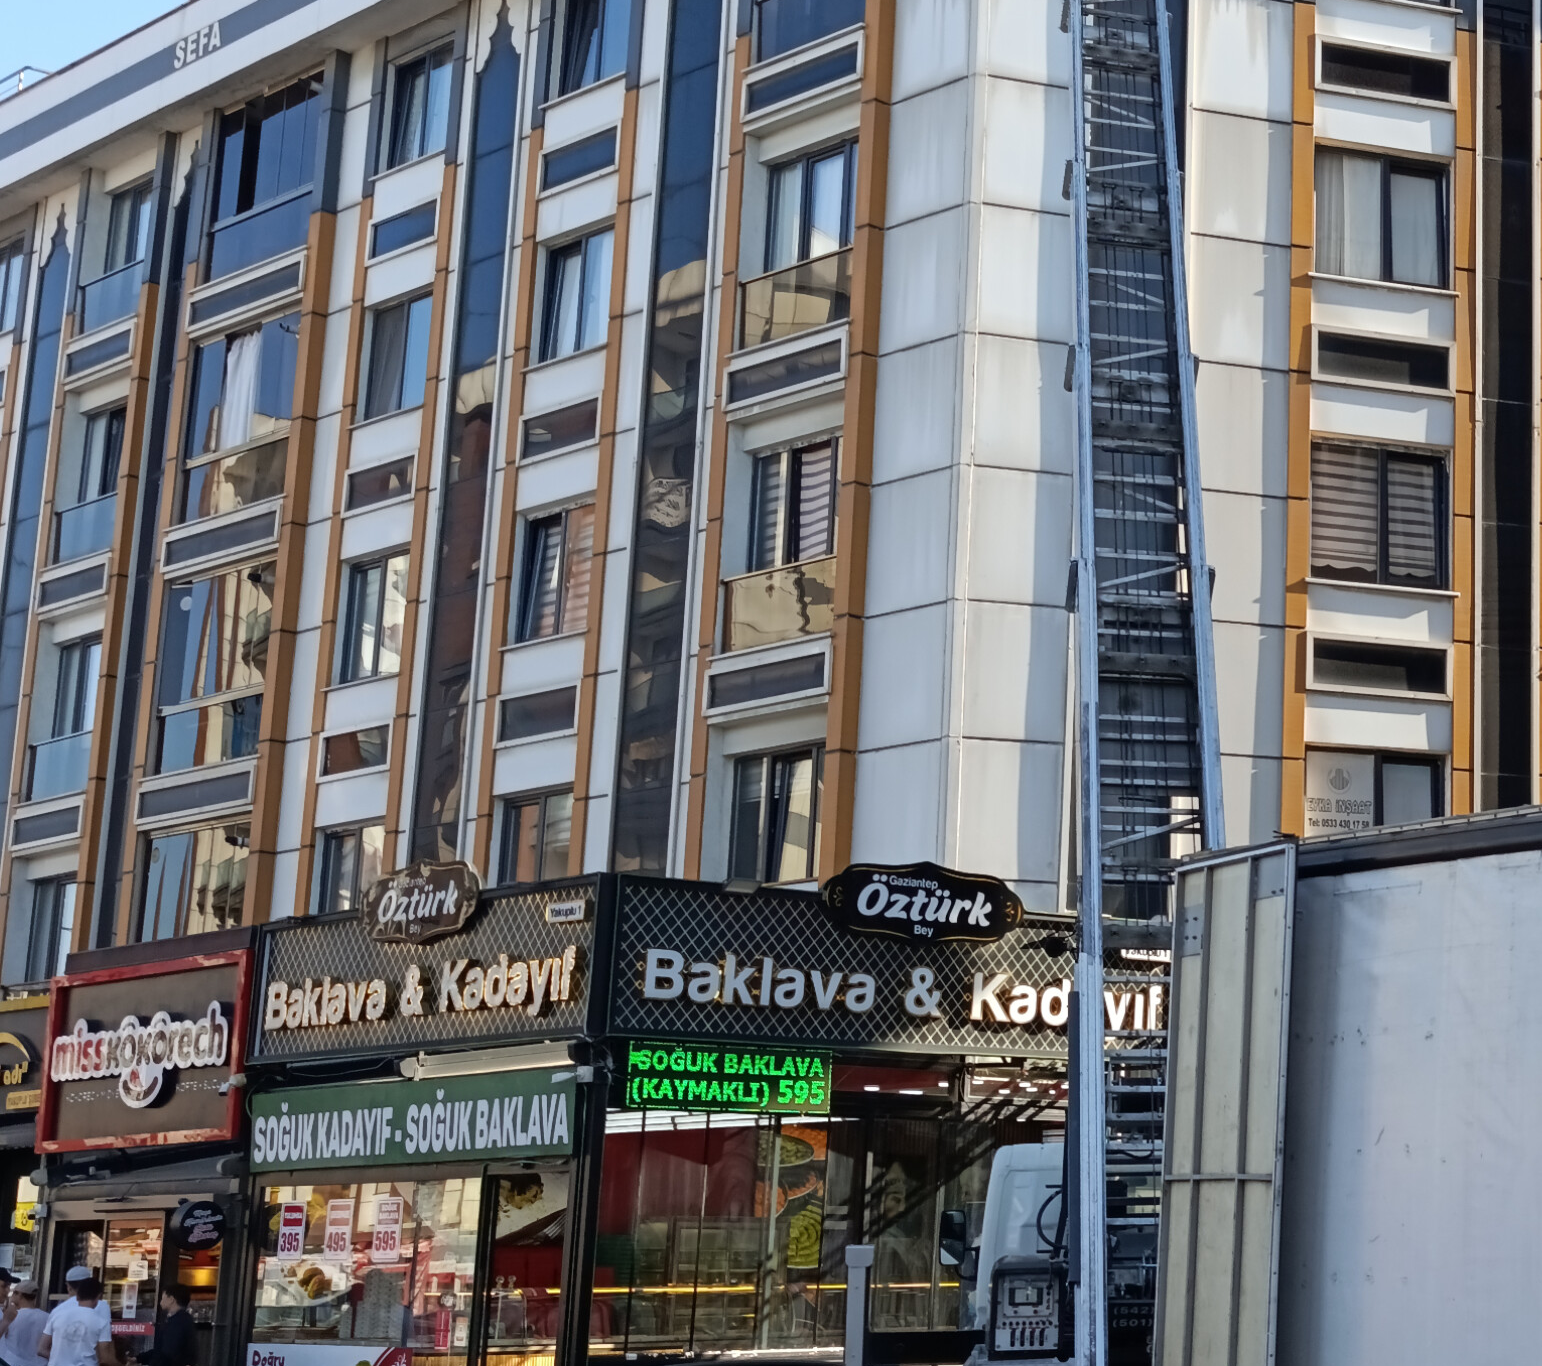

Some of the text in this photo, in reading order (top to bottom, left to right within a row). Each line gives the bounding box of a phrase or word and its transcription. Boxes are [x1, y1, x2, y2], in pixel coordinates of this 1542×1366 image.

[173, 21, 221, 69] SEFA
[889, 875, 938, 890] Gaziantep
[378, 880, 458, 923] Öztürk
[857, 874, 992, 927] Öztürk
[914, 925, 933, 937] Bey
[266, 945, 577, 1031] Baklava & Kadayıf
[644, 949, 1163, 1037] Baklava & Kadyıf
[724, 1053, 825, 1077] BAKLAVA
[777, 1080, 825, 1105] 595
[253, 1102, 315, 1163] SOĞUK
[316, 1107, 393, 1158] KADAYIF
[405, 1088, 473, 1154] SOĞUK
[475, 1093, 569, 1149] BAKLAVA
[280, 1232, 300, 1252] 395
[326, 1232, 346, 1252] 495
[374, 1230, 396, 1251] 595
[111, 1324, 146, 1334] OŞGELDİNİZ
